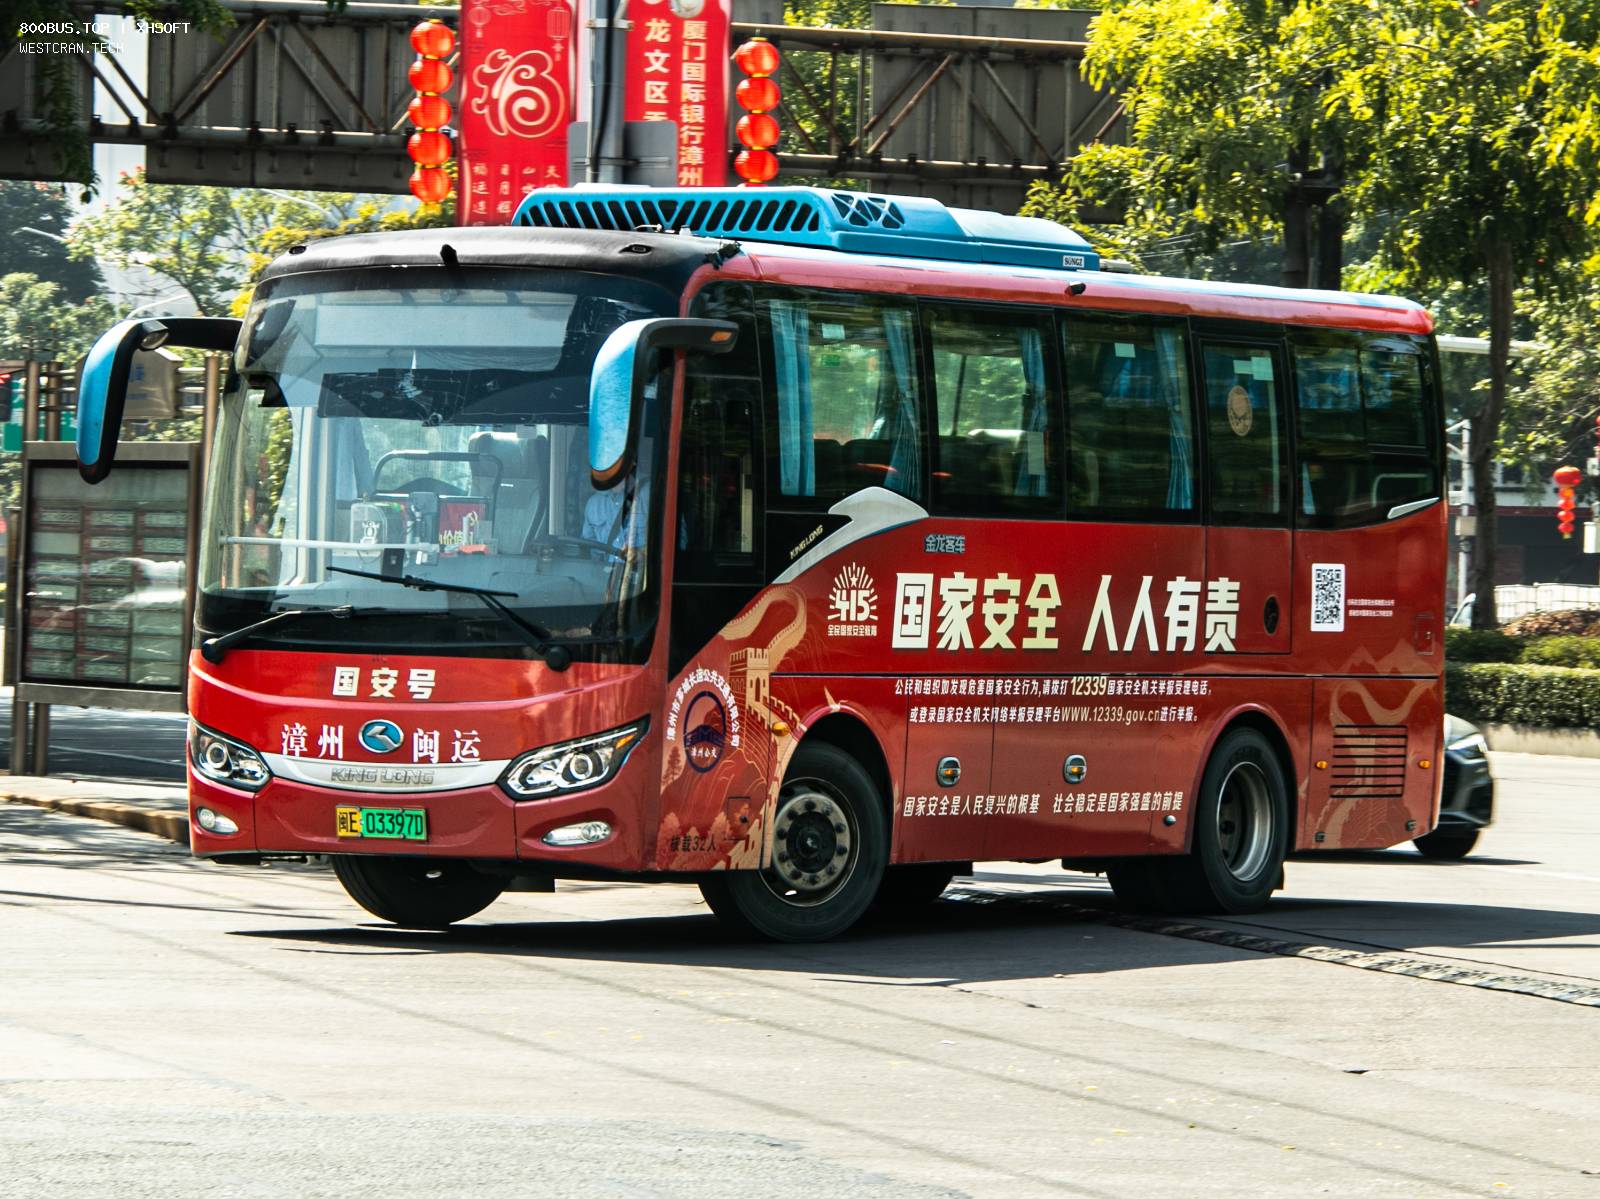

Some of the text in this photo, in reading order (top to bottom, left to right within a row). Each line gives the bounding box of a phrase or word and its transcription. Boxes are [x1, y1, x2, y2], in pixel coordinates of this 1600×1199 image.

[679, 20, 707, 186] 厦门国际银行漳州
[925, 534, 966, 553] 金龙客车
[892, 572, 1241, 653] 国家安全 人人有责
[332, 666, 436, 699] 国安号
[281, 723, 481, 763] 漳州 闽运
[331, 768, 434, 785] KING LONG
[903, 792, 1184, 817] 国家安全是人民复兴的根基 社会稳定是国家强盛的前提
[365, 812, 423, 836] 03397D
